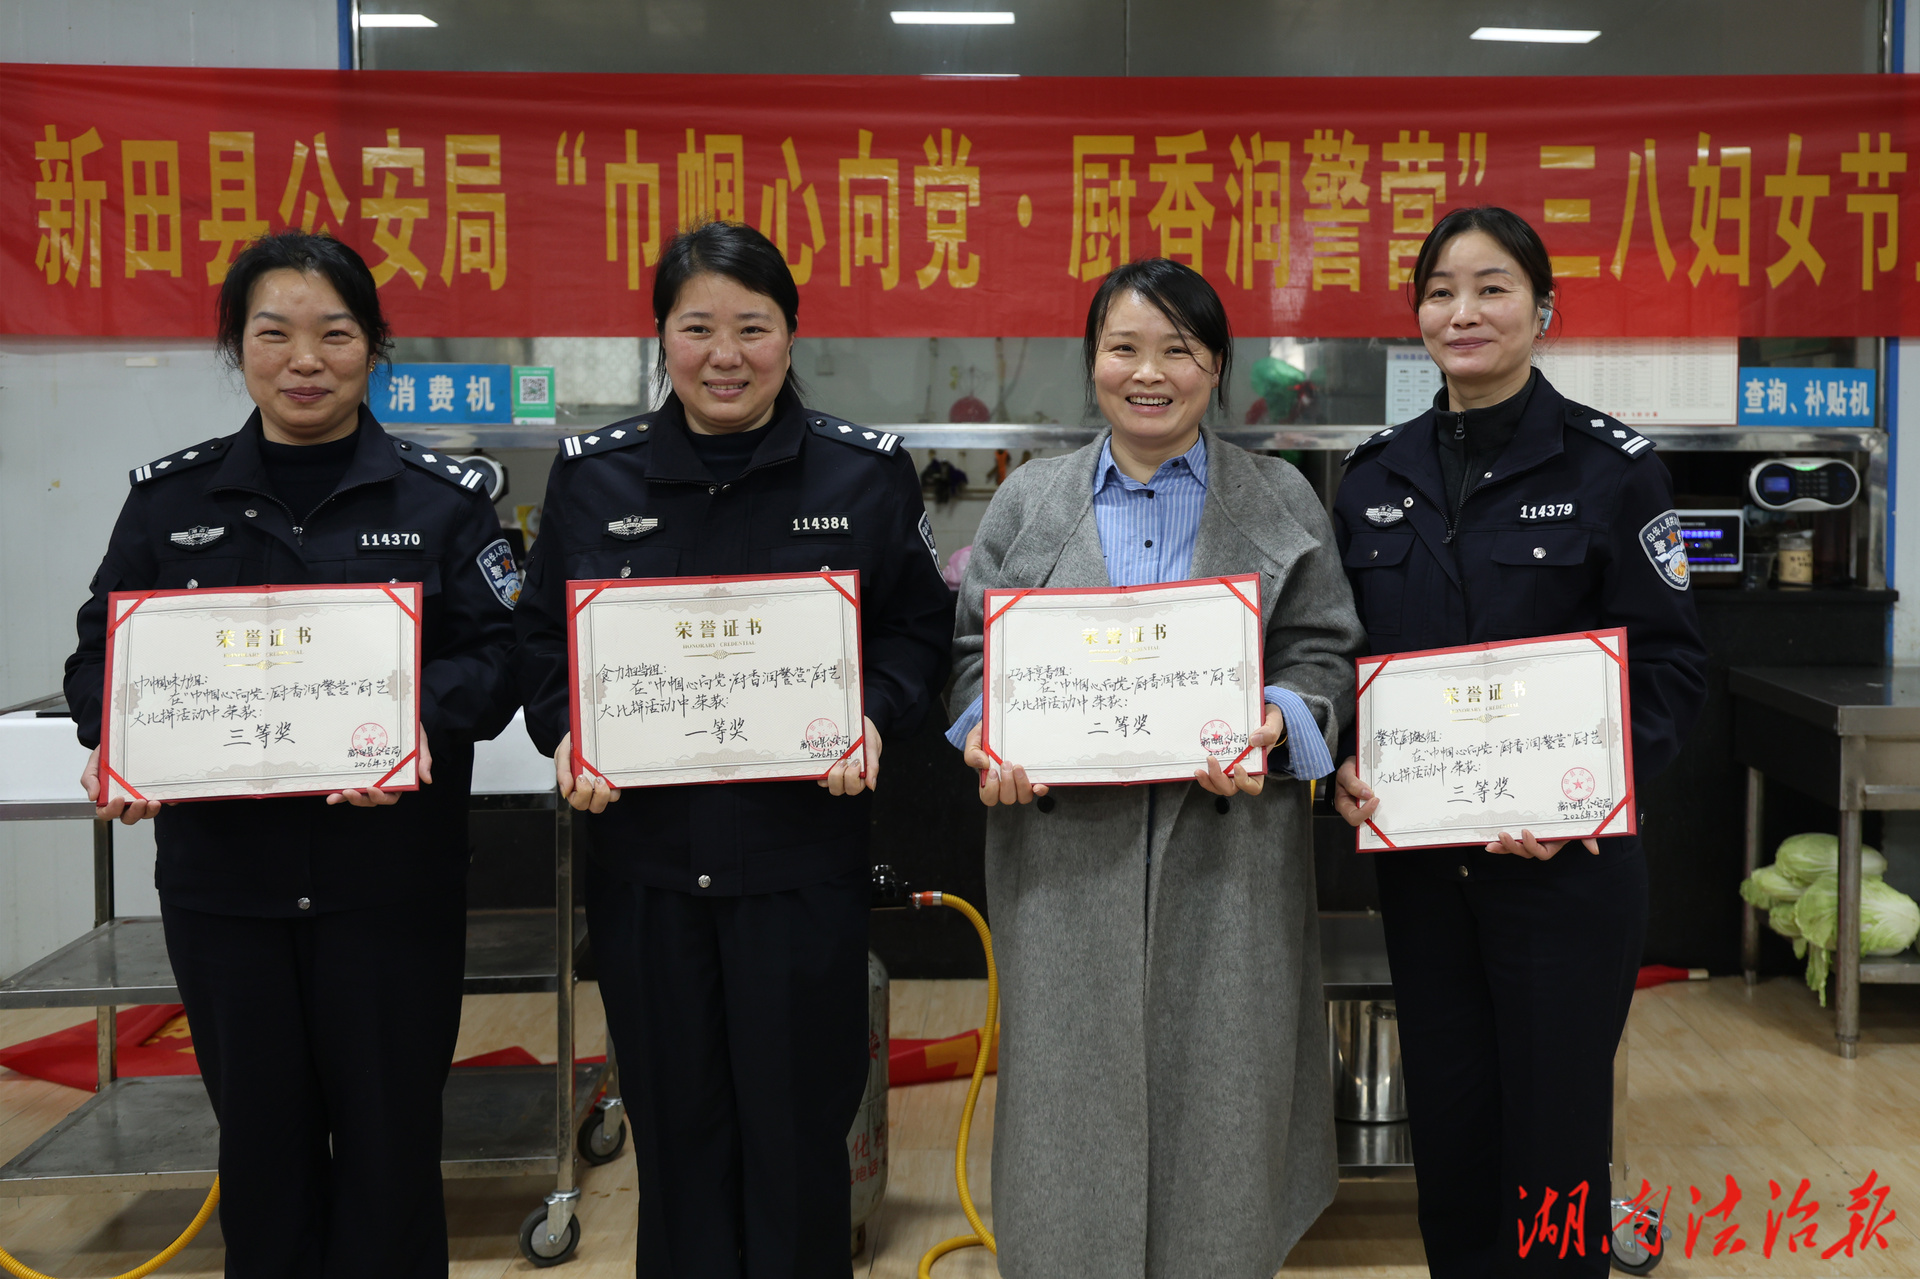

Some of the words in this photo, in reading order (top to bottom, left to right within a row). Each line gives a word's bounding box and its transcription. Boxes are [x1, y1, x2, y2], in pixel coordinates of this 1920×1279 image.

[34, 124, 508, 291] 新田县公安局
[1539, 131, 1920, 291] 三八妇女节
[388, 374, 496, 412] 消费机
[1744, 377, 1870, 417] 查询、补贴机
[792, 516, 849, 531] 114384
[1519, 503, 1574, 519] 114379
[360, 533, 421, 546] 114370
[215, 626, 312, 649] 荣誉证书
[675, 617, 762, 640] 荣誉证书
[1081, 623, 1167, 645] 荣誉证书
[1442, 680, 1527, 705] 荣誉证书
[223, 721, 296, 750] 三等奖
[685, 716, 748, 744] 一等奖
[1087, 713, 1151, 738] 二等奖
[1447, 776, 1515, 804] 三等奖
